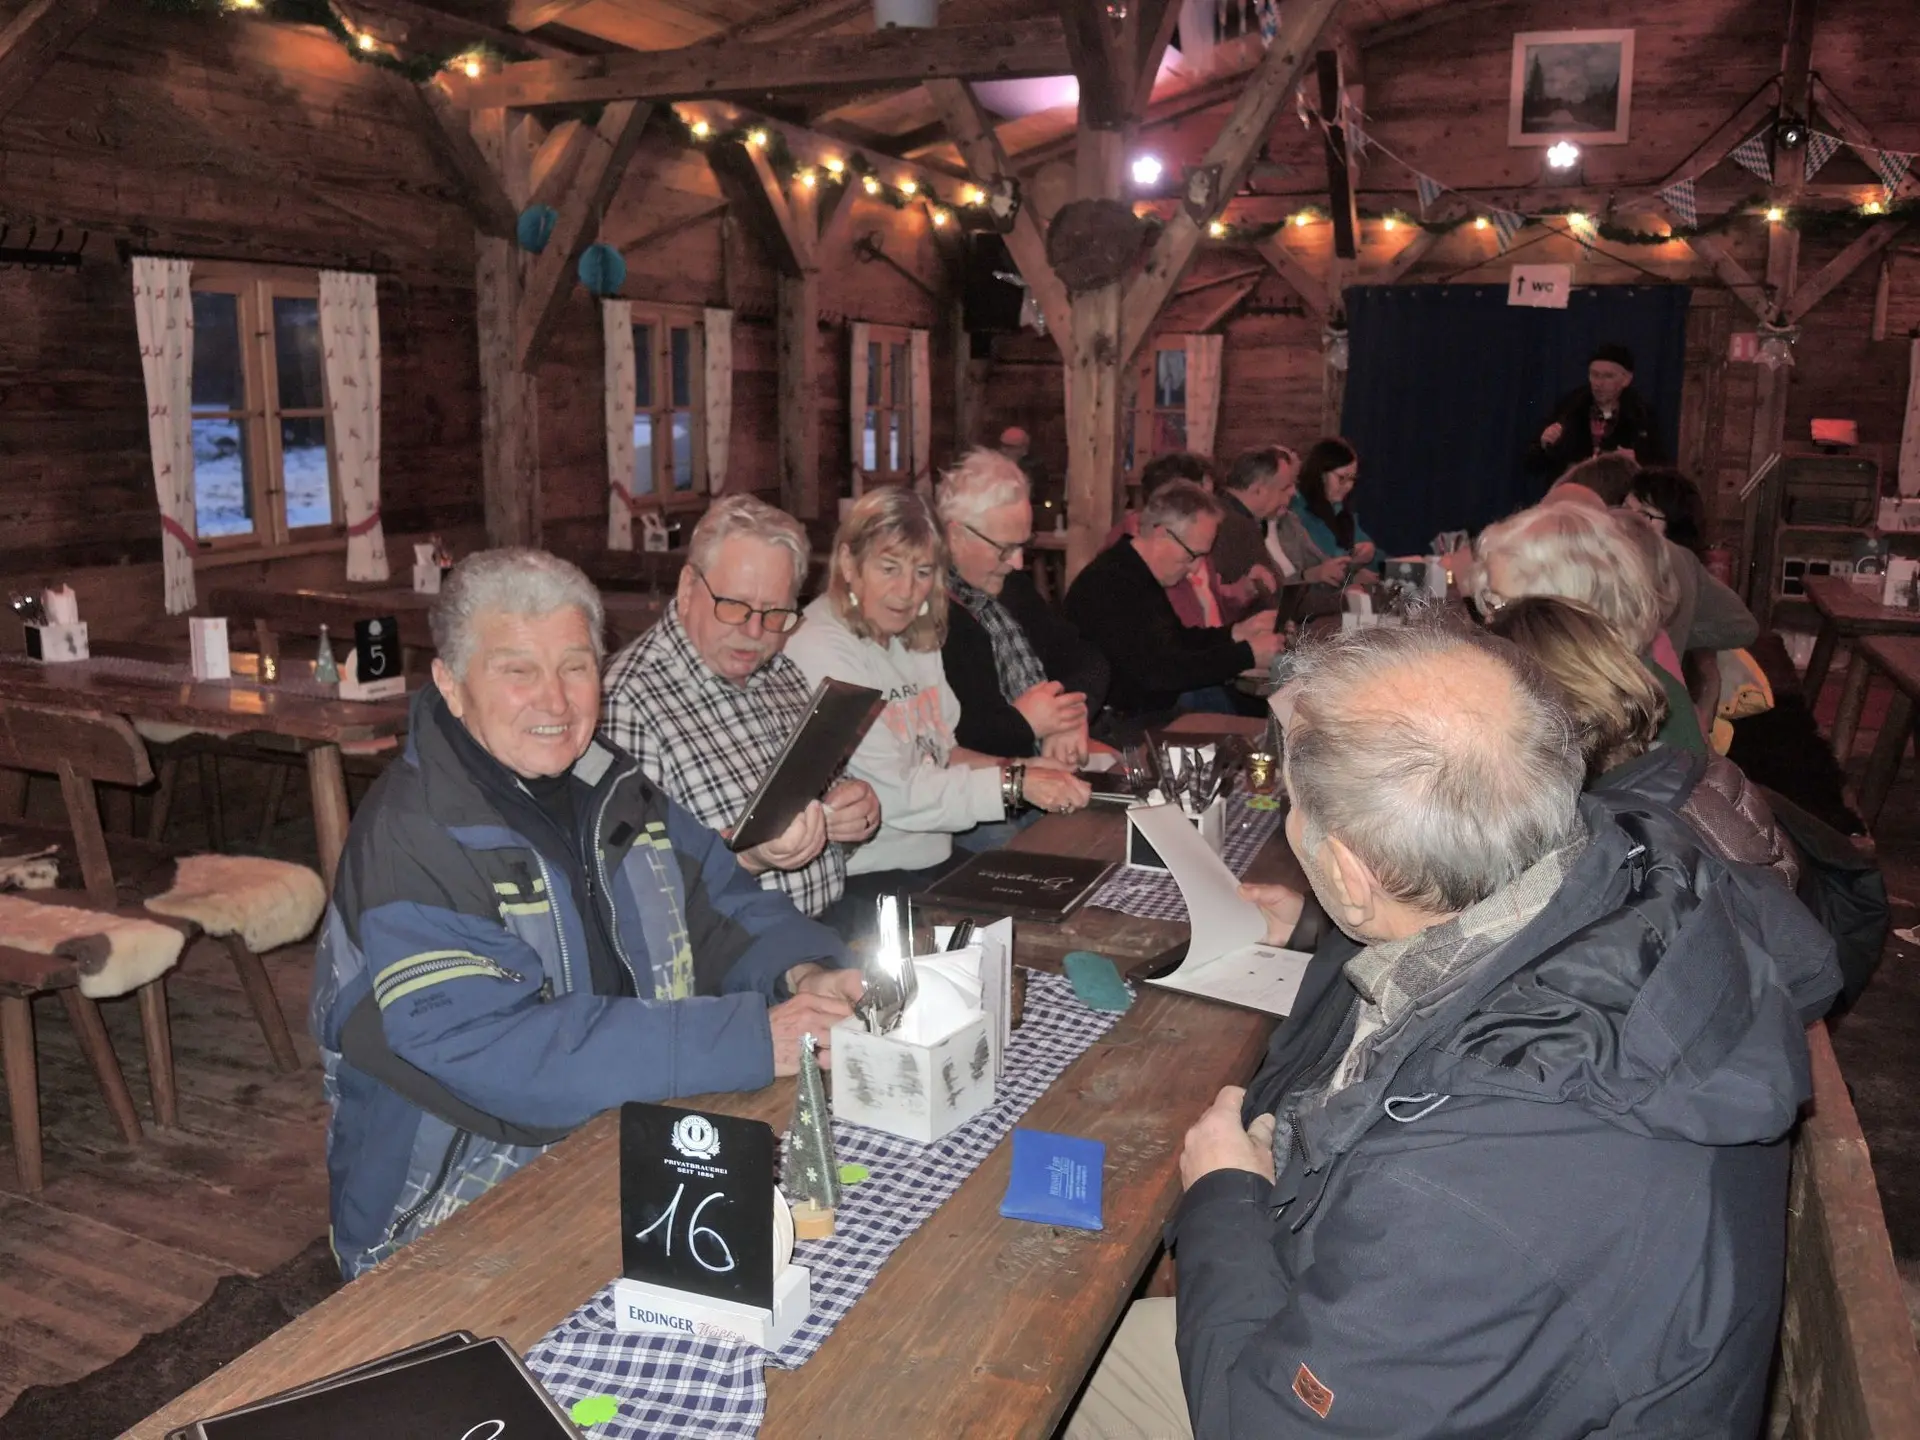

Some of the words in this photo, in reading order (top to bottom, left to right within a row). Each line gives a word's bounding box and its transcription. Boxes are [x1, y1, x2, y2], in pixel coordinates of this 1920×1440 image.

[1532, 281, 1554, 293] WC
[369, 644, 386, 676] 5
[663, 1158, 728, 1175] PRIVATBRAUEREI
[676, 1167, 695, 1175] SEIT
[634, 1182, 736, 1273] 16
[628, 1305, 695, 1334] ERDINGER
